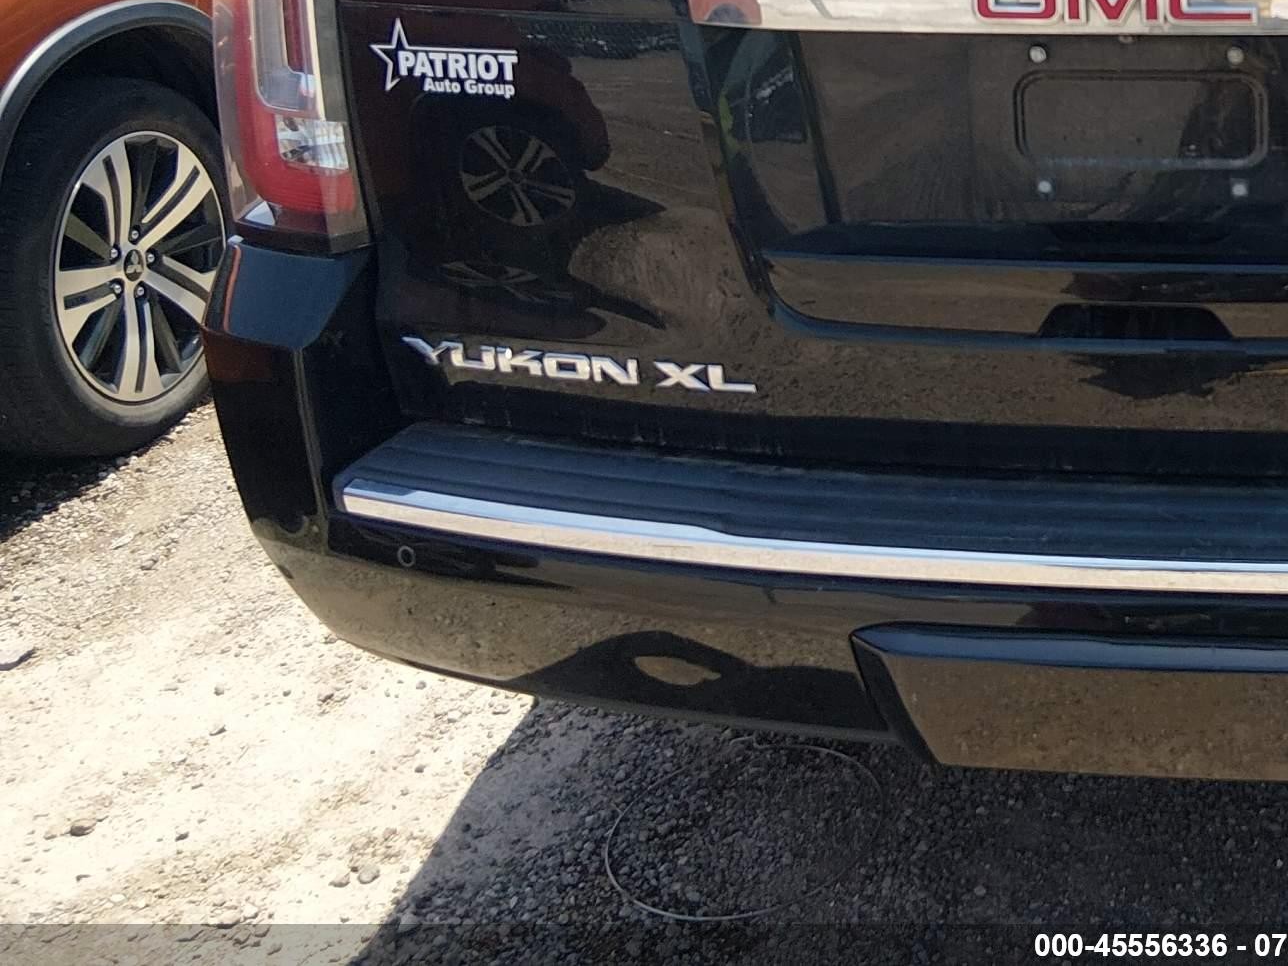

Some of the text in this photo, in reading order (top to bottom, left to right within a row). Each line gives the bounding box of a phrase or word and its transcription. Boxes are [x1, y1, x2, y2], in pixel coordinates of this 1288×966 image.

[398, 50, 518, 81] PATRIOT
[423, 77, 515, 99] Auto Group
[401, 336, 757, 393] YUKON XL
